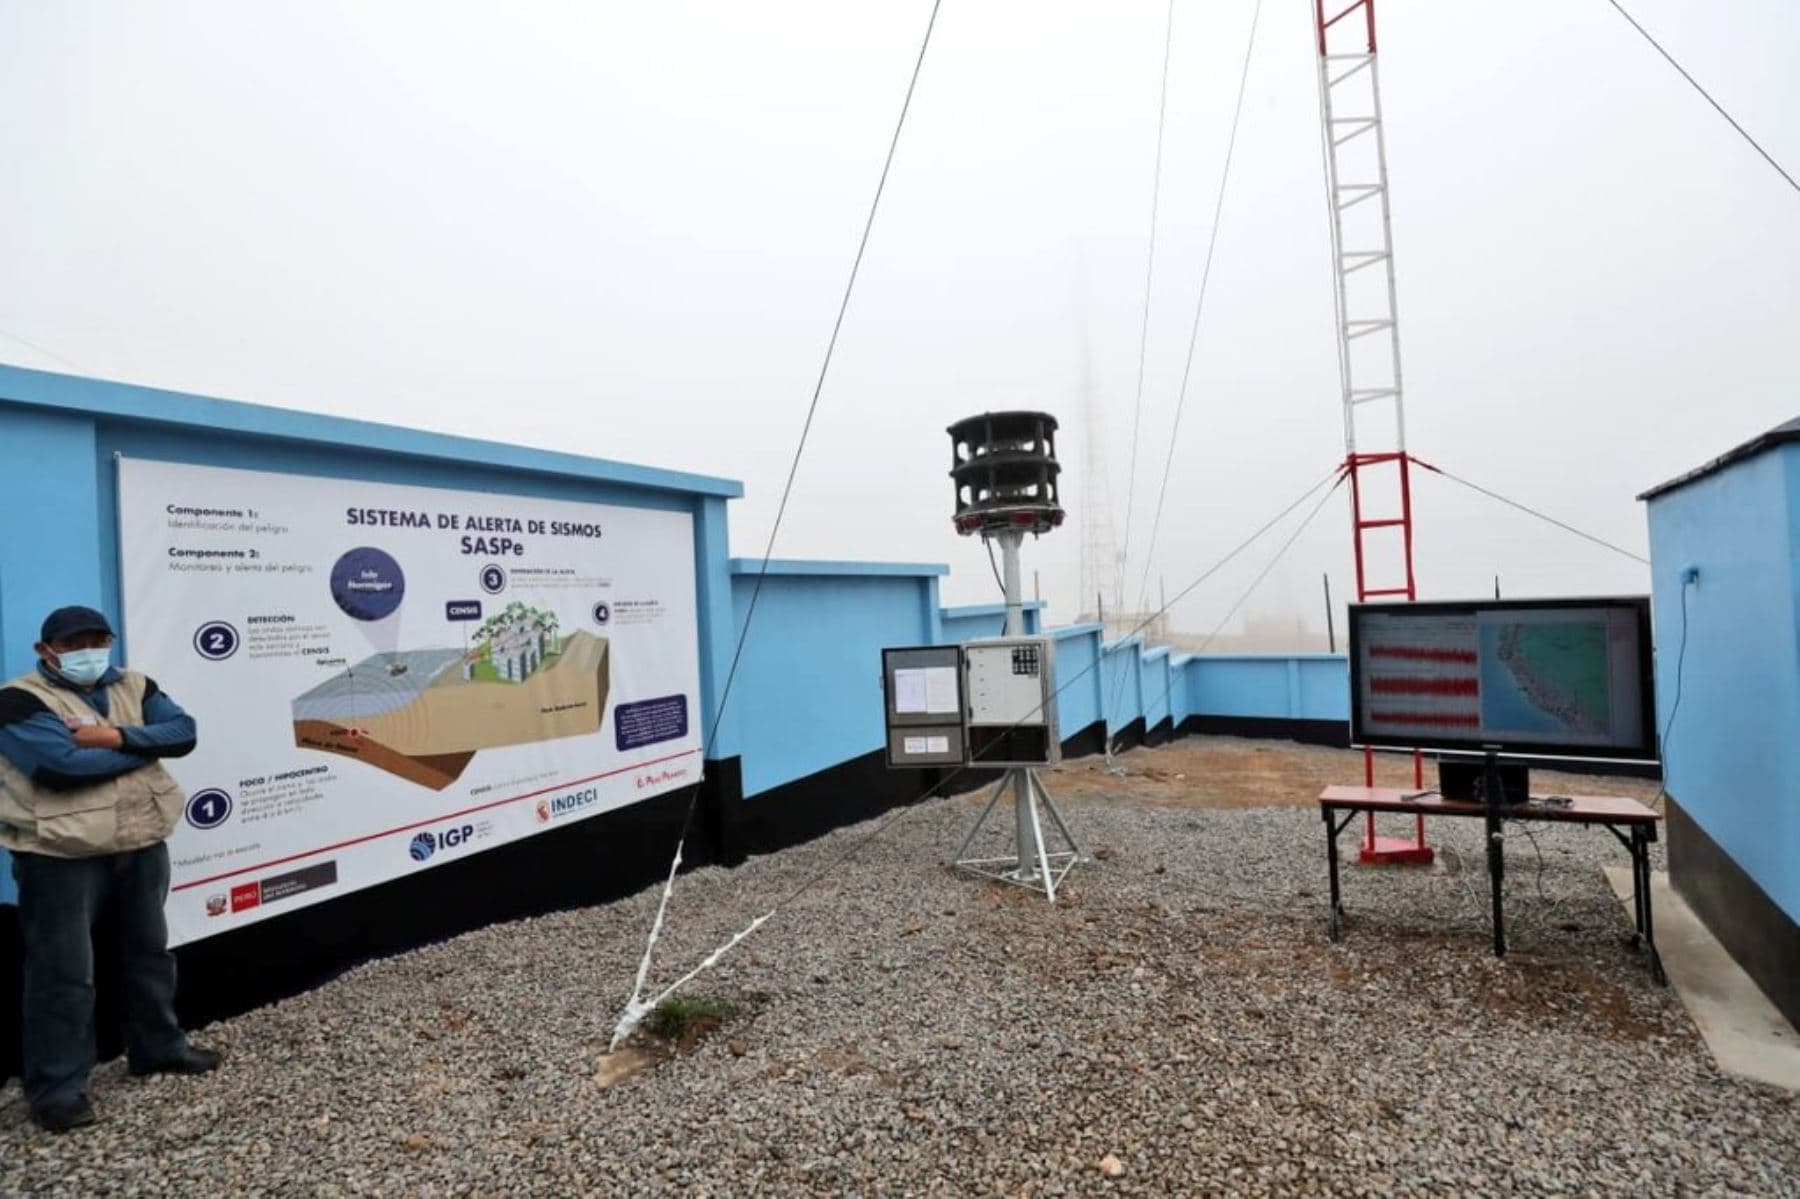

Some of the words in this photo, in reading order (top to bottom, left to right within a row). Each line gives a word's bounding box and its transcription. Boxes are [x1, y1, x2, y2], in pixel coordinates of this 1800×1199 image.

[166, 503, 243, 518] Componente
[247, 508, 259, 519] 1:
[346, 506, 431, 529] SISTEMA
[437, 513, 459, 530] DE
[465, 515, 523, 534] ALERTA
[528, 519, 546, 535] DE
[551, 521, 602, 539] SISMOS
[168, 546, 246, 560] Componente
[248, 549, 260, 559] 2:
[460, 535, 525, 556] SASPe
[488, 573, 499, 587] 3
[209, 633, 225, 650] 2
[239, 777, 266, 788] FOCO
[551, 788, 598, 813] INDECI
[202, 801, 214, 817] 1
[438, 824, 474, 851] IGP
